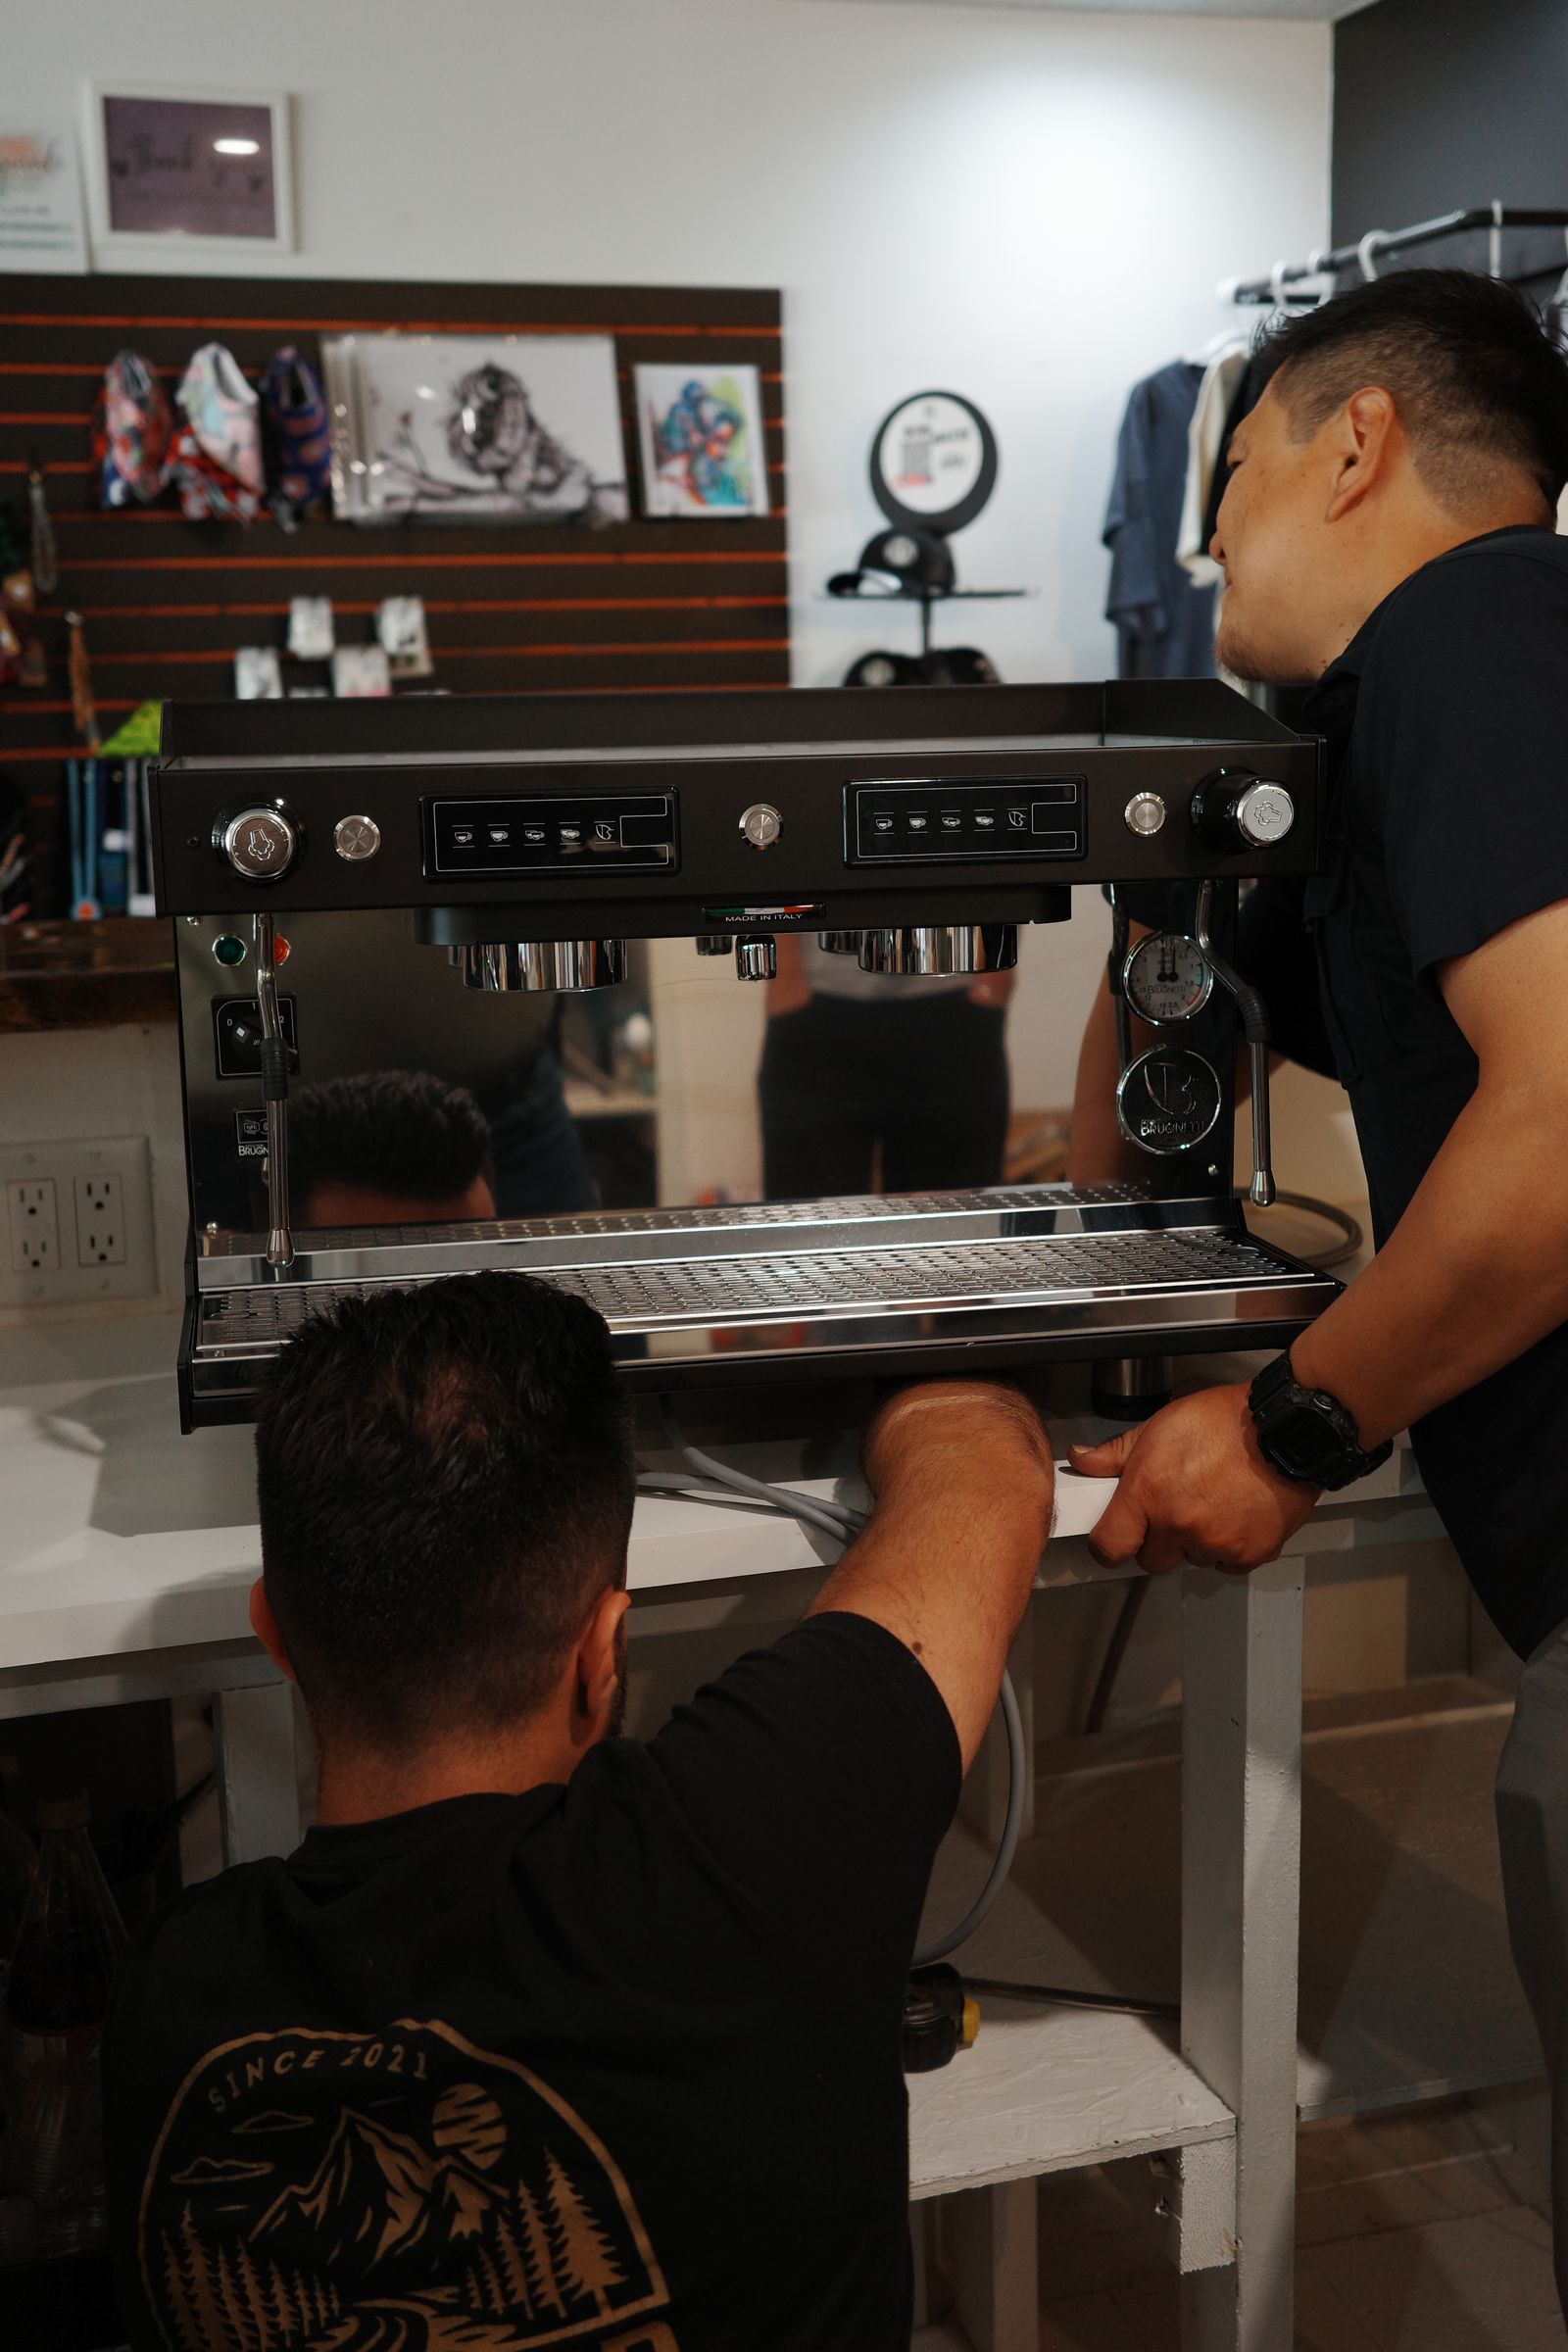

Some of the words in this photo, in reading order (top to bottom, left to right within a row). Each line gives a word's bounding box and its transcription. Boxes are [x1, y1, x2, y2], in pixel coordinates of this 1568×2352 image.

[226, 1018, 233, 1027] 0
[208, 2050, 324, 2113] SINCE
[340, 2042, 428, 2081] 2021
